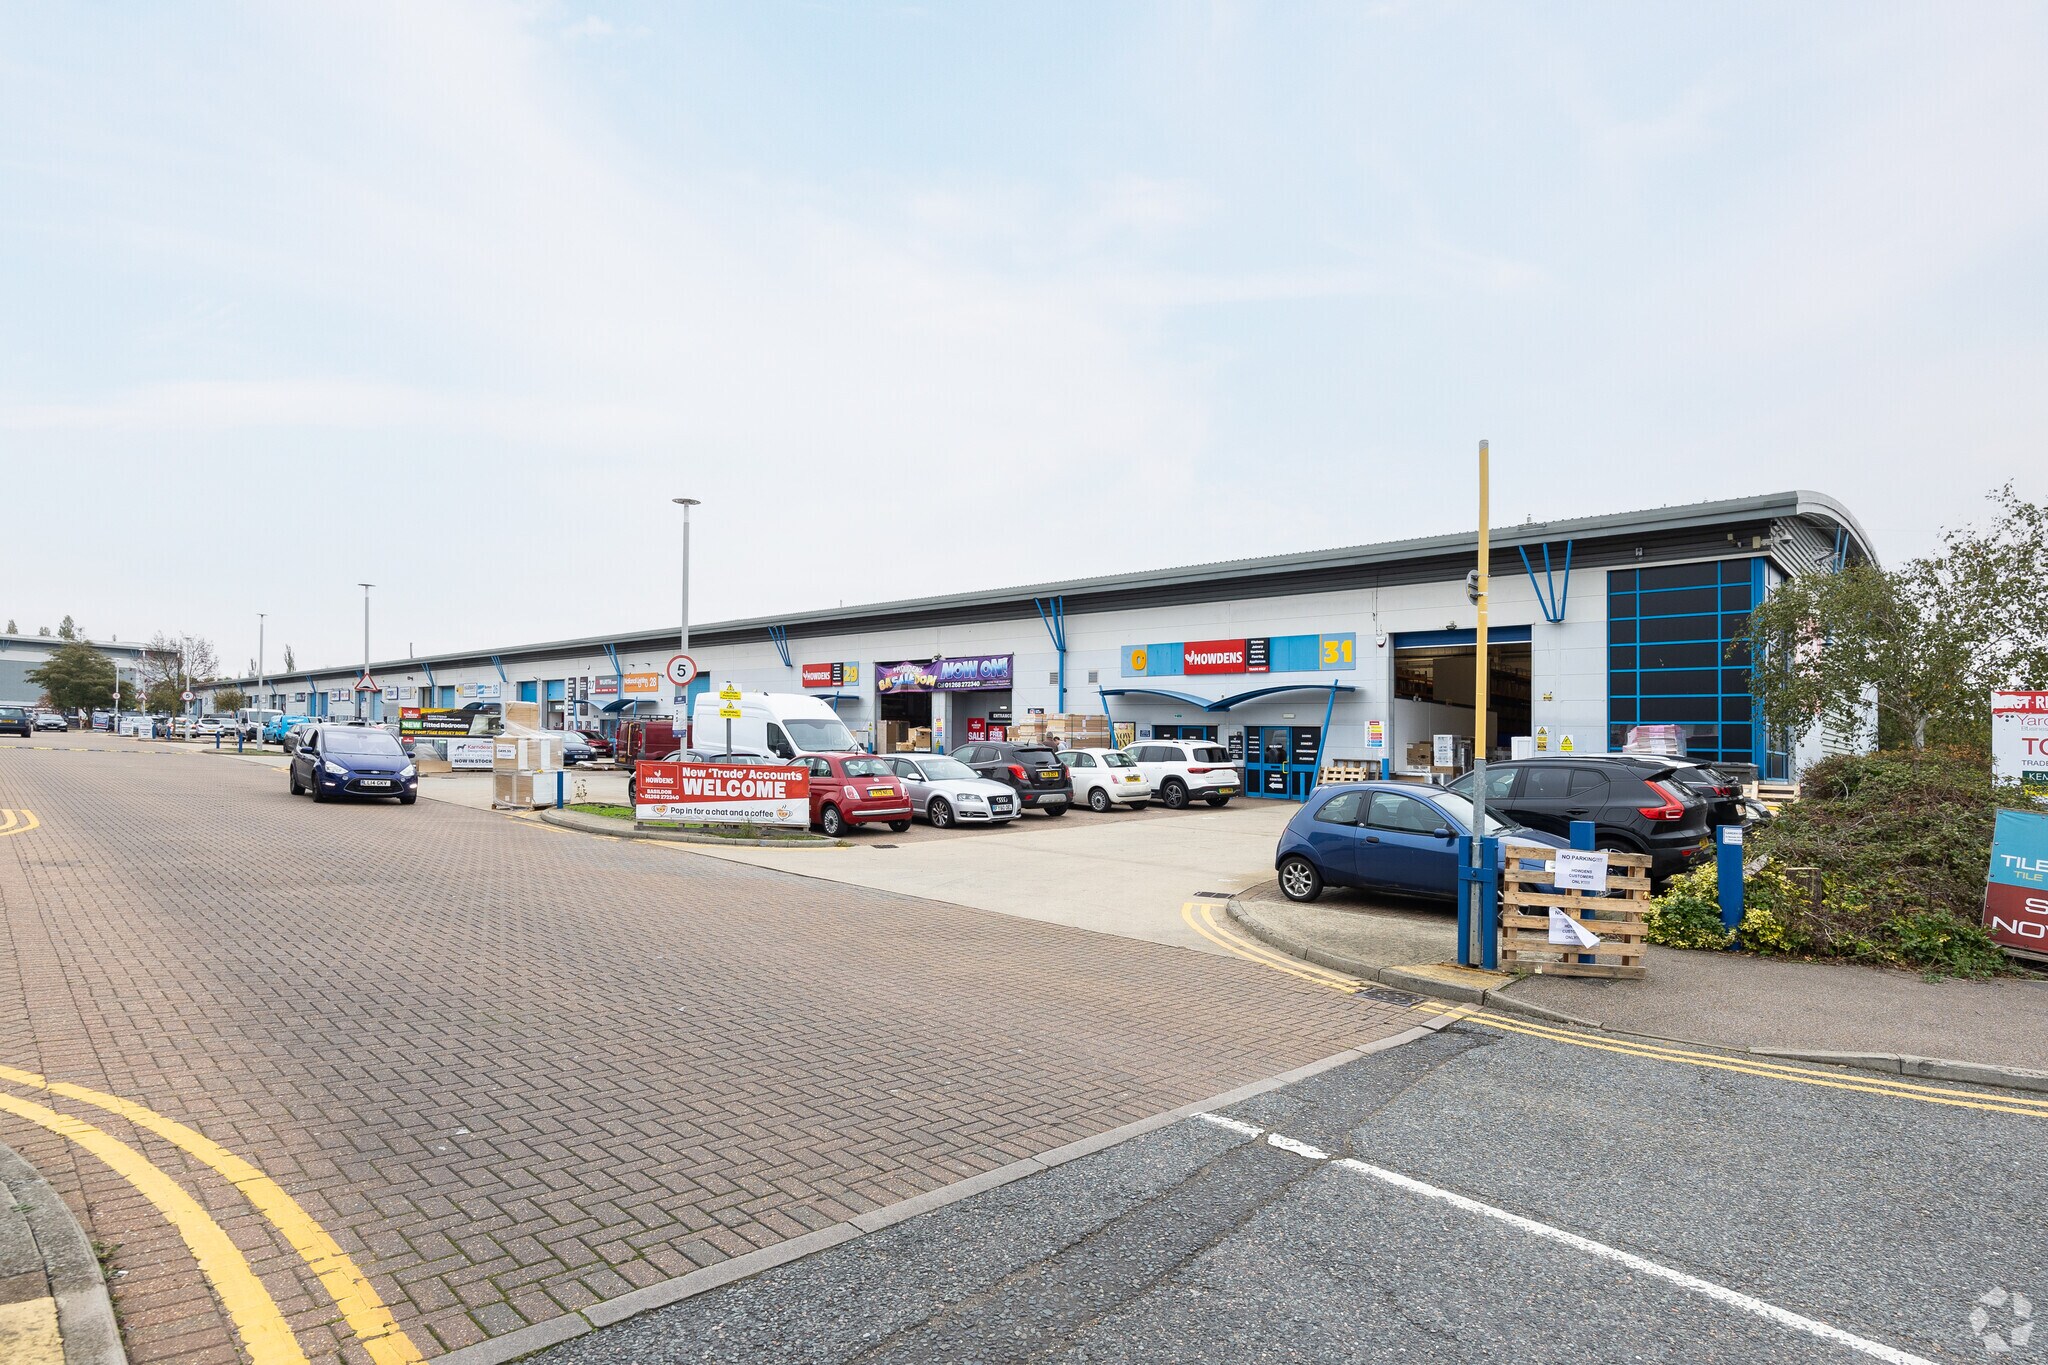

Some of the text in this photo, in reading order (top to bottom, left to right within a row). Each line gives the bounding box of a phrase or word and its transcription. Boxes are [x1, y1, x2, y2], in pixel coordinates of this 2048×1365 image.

[1194, 652, 1242, 664] HOWDENS
[1324, 640, 1352, 664] 31
[677, 664, 686, 677] 5
[844, 666, 857, 682] 29
[941, 658, 1008, 679] NOW ON!
[650, 677, 657, 686] 28
[807, 672, 830, 680] HOWDENS
[968, 732, 984, 740] SALE
[683, 767, 706, 777] New
[749, 770, 802, 780] Accounts
[683, 778, 786, 798] WELCOME
[750, 809, 773, 817] coffee
[2014, 870, 2043, 882] TILE
